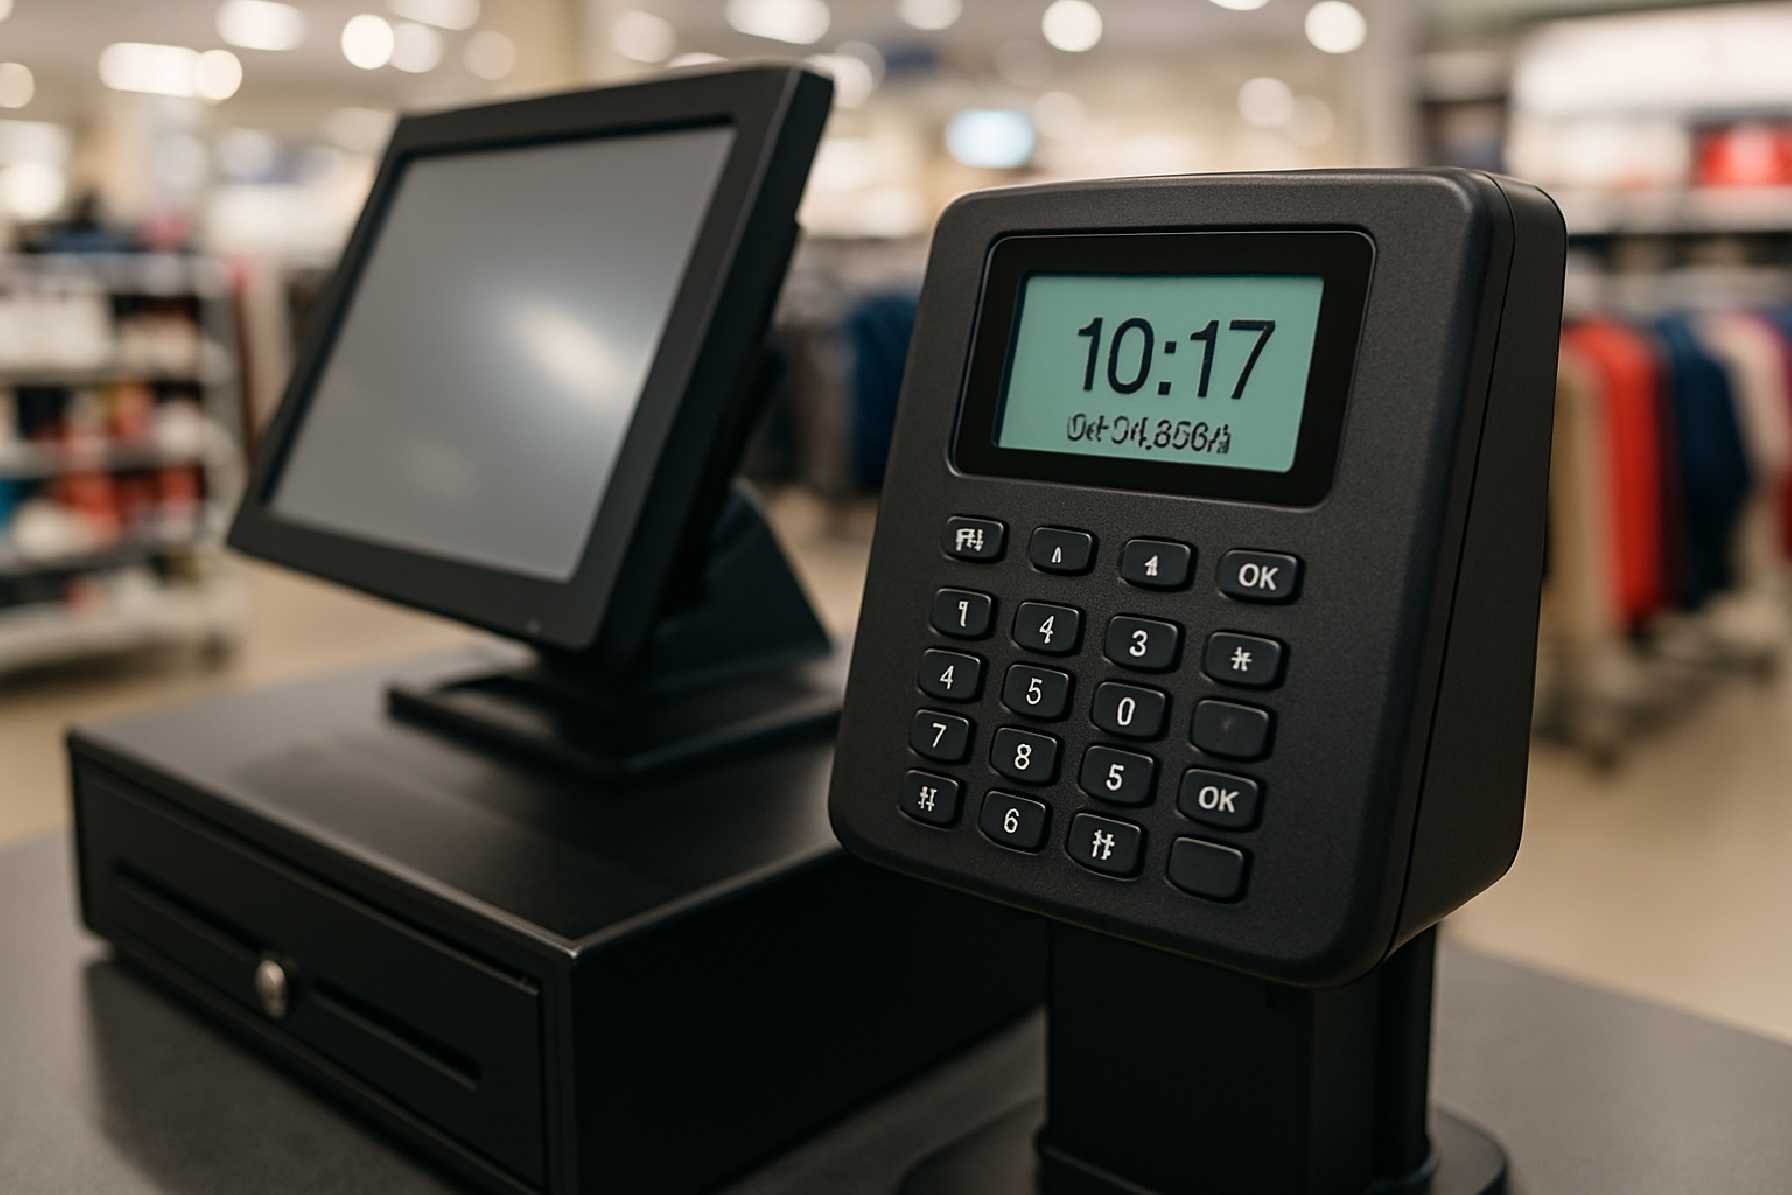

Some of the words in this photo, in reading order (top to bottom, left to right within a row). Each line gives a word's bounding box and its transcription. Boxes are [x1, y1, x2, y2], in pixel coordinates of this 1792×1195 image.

[1077, 316, 1277, 401] 10:17
[1238, 563, 1278, 591] OK
[1129, 630, 1147, 657] 3
[939, 665, 954, 690] 4
[1025, 677, 1042, 705] 5
[1117, 696, 1136, 726] 0
[932, 722, 947, 747] 7
[1014, 743, 1032, 770] 8
[1106, 763, 1124, 791] 5
[1198, 786, 1238, 813] OK
[1003, 807, 1020, 834] 6
